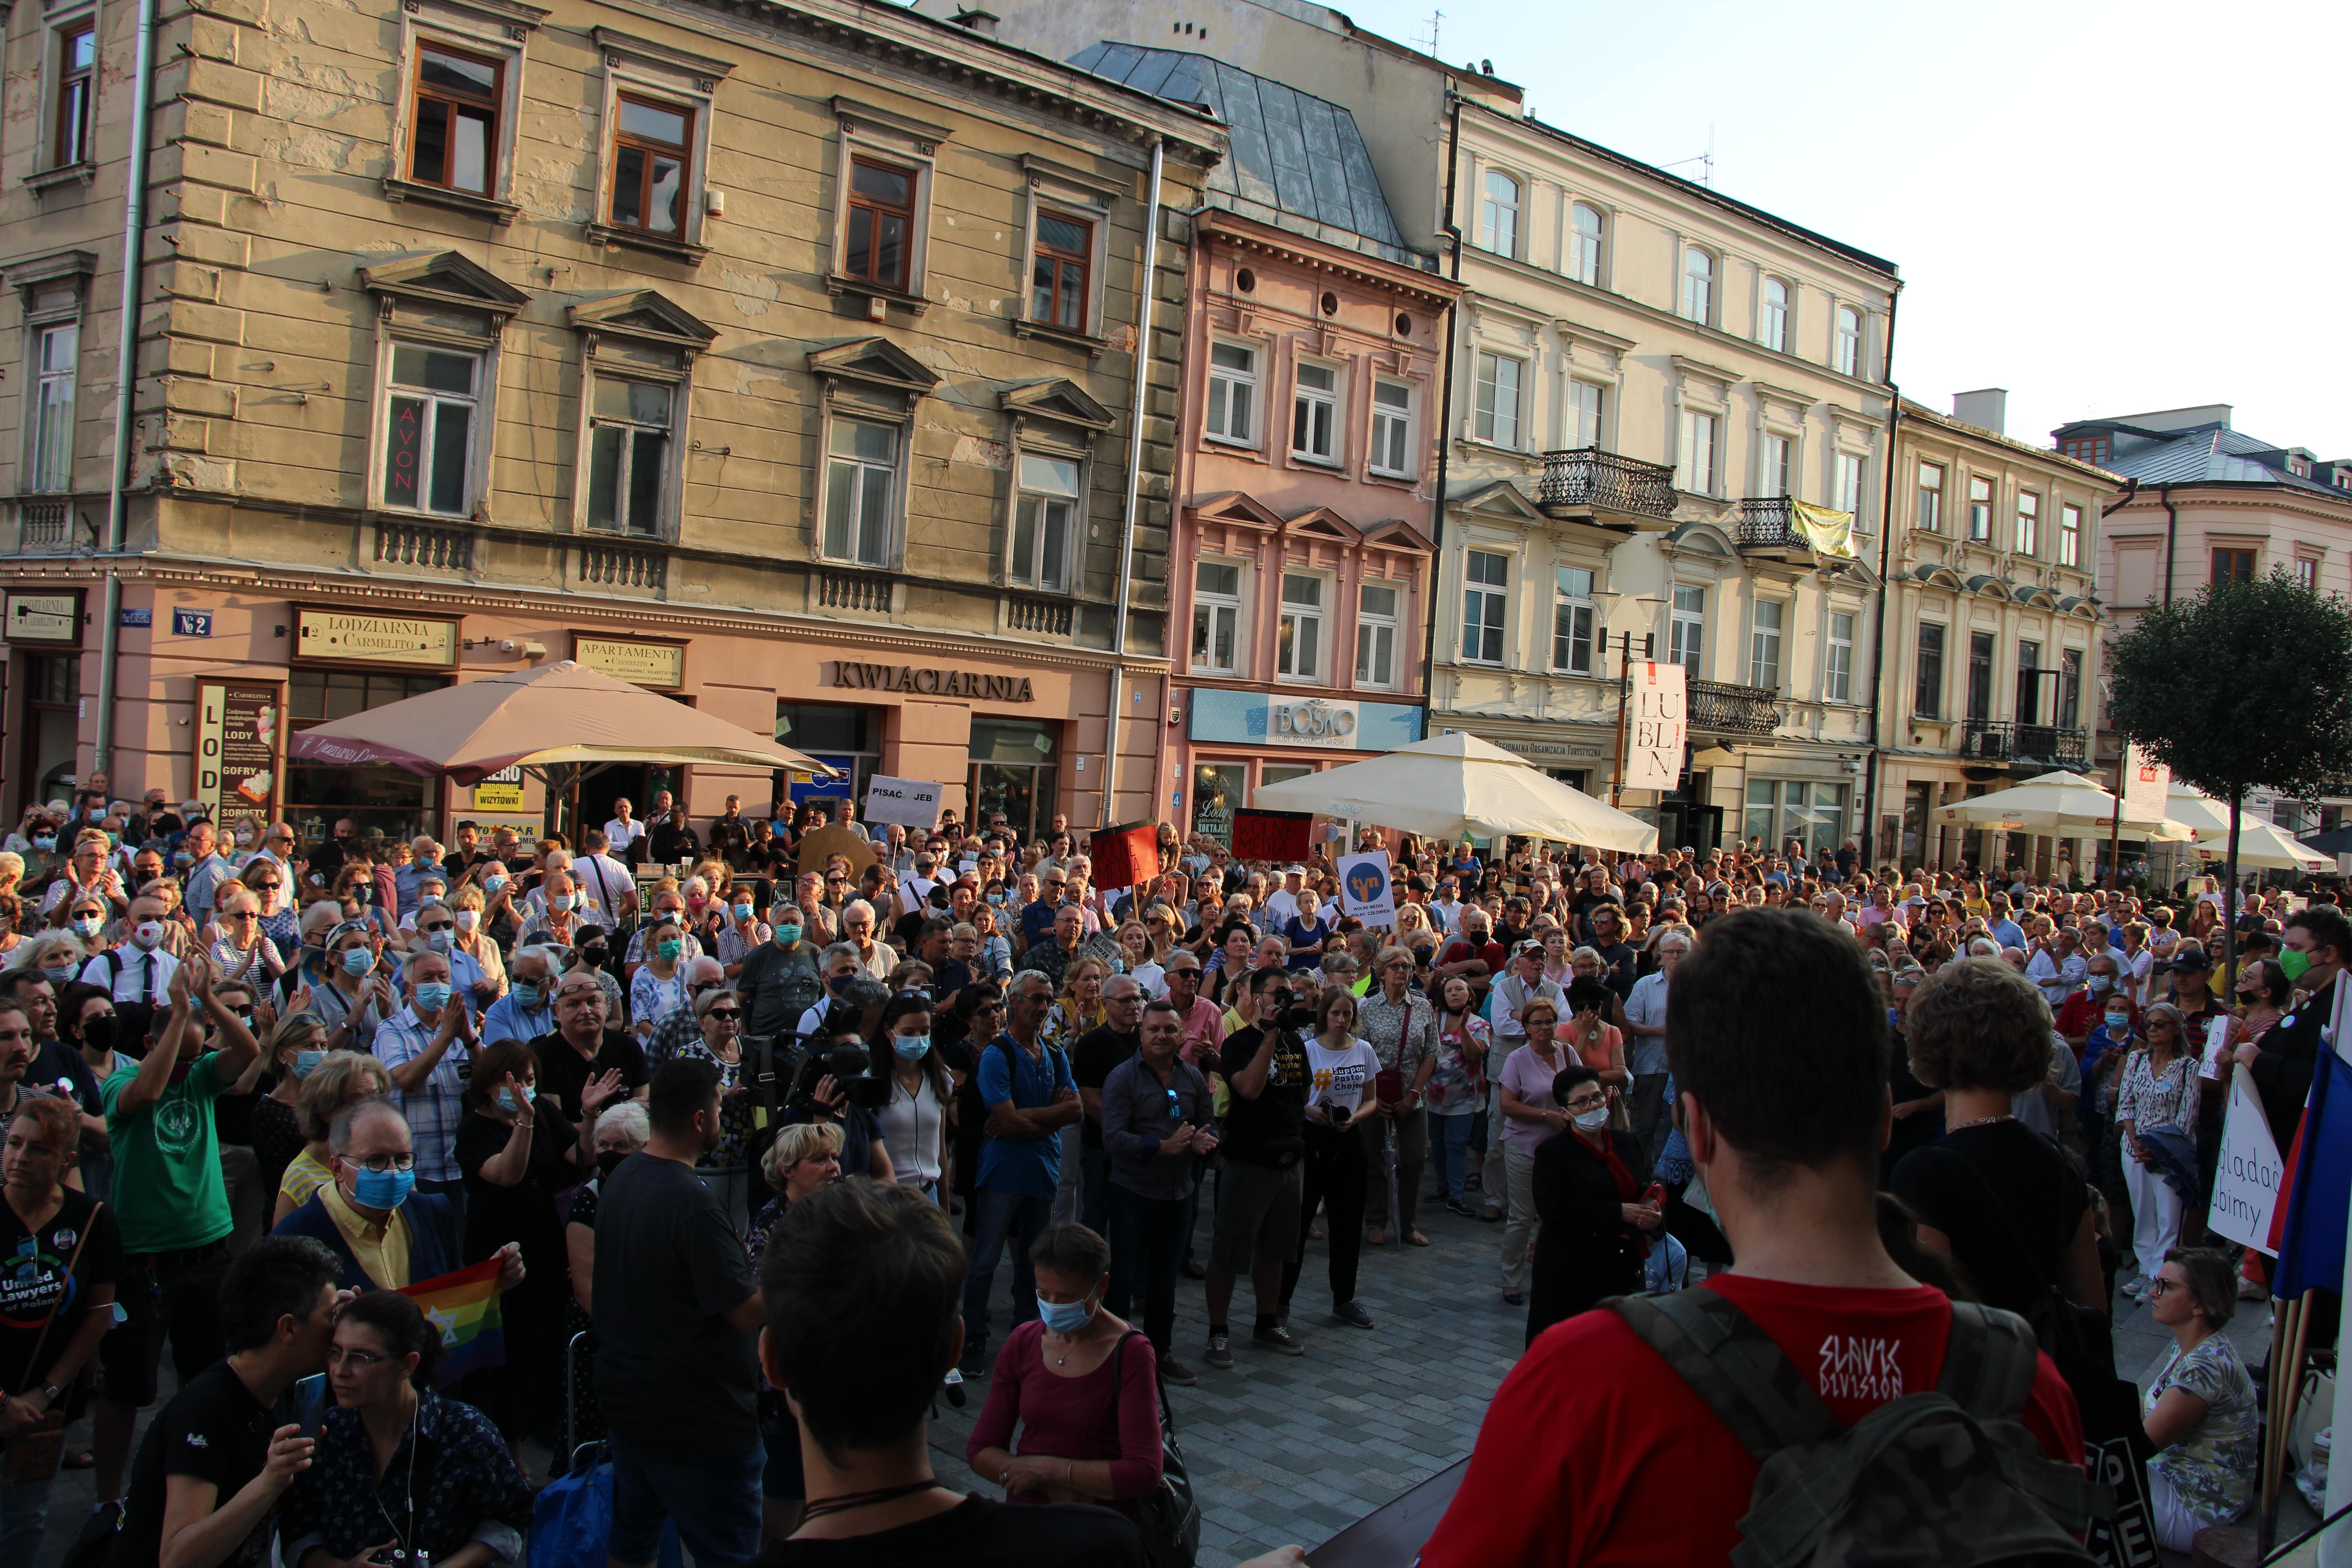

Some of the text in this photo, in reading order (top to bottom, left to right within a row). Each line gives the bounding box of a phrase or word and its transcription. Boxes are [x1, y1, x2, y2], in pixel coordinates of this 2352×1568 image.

[396, 407, 415, 489] AVON
[196, 617, 205, 634] 2
[311, 628, 318, 637] 2
[328, 617, 429, 636] LODZIARNIA
[343, 632, 414, 650] CARMELITO
[438, 637, 445, 646] 2
[582, 644, 677, 660] APARTAMENTY
[612, 657, 647, 667] CARMELITO
[834, 661, 1036, 702] KWIACIARNIA
[225, 731, 253, 739] LODY
[1275, 735, 1348, 746] LODY PRODUKCJI WŁASNEJ
[1495, 740, 1601, 757] REGIONALNA ORGANIZACJA TURYSTYCZNA
[222, 766, 257, 775] GOFRY
[480, 795, 518, 804] WIZYTÓWKI
[872, 788, 933, 802] PISAĆ JEB
[1173, 795, 1180, 806] 4
[1199, 800, 1229, 823] Lody
[1198, 824, 1228, 833] KOKTAJLE
[1239, 817, 1296, 839] WOLNE
[1095, 833, 1136, 863] WOLNE
[1239, 837, 1289, 857] MEDIA
[1098, 857, 1142, 887] MEDIA
[1274, 1053, 1302, 1062] Support
[1334, 1065, 1365, 1075] Support
[0, 1281, 62, 1303] Lawyers
[22, 1297, 62, 1310] Polan
